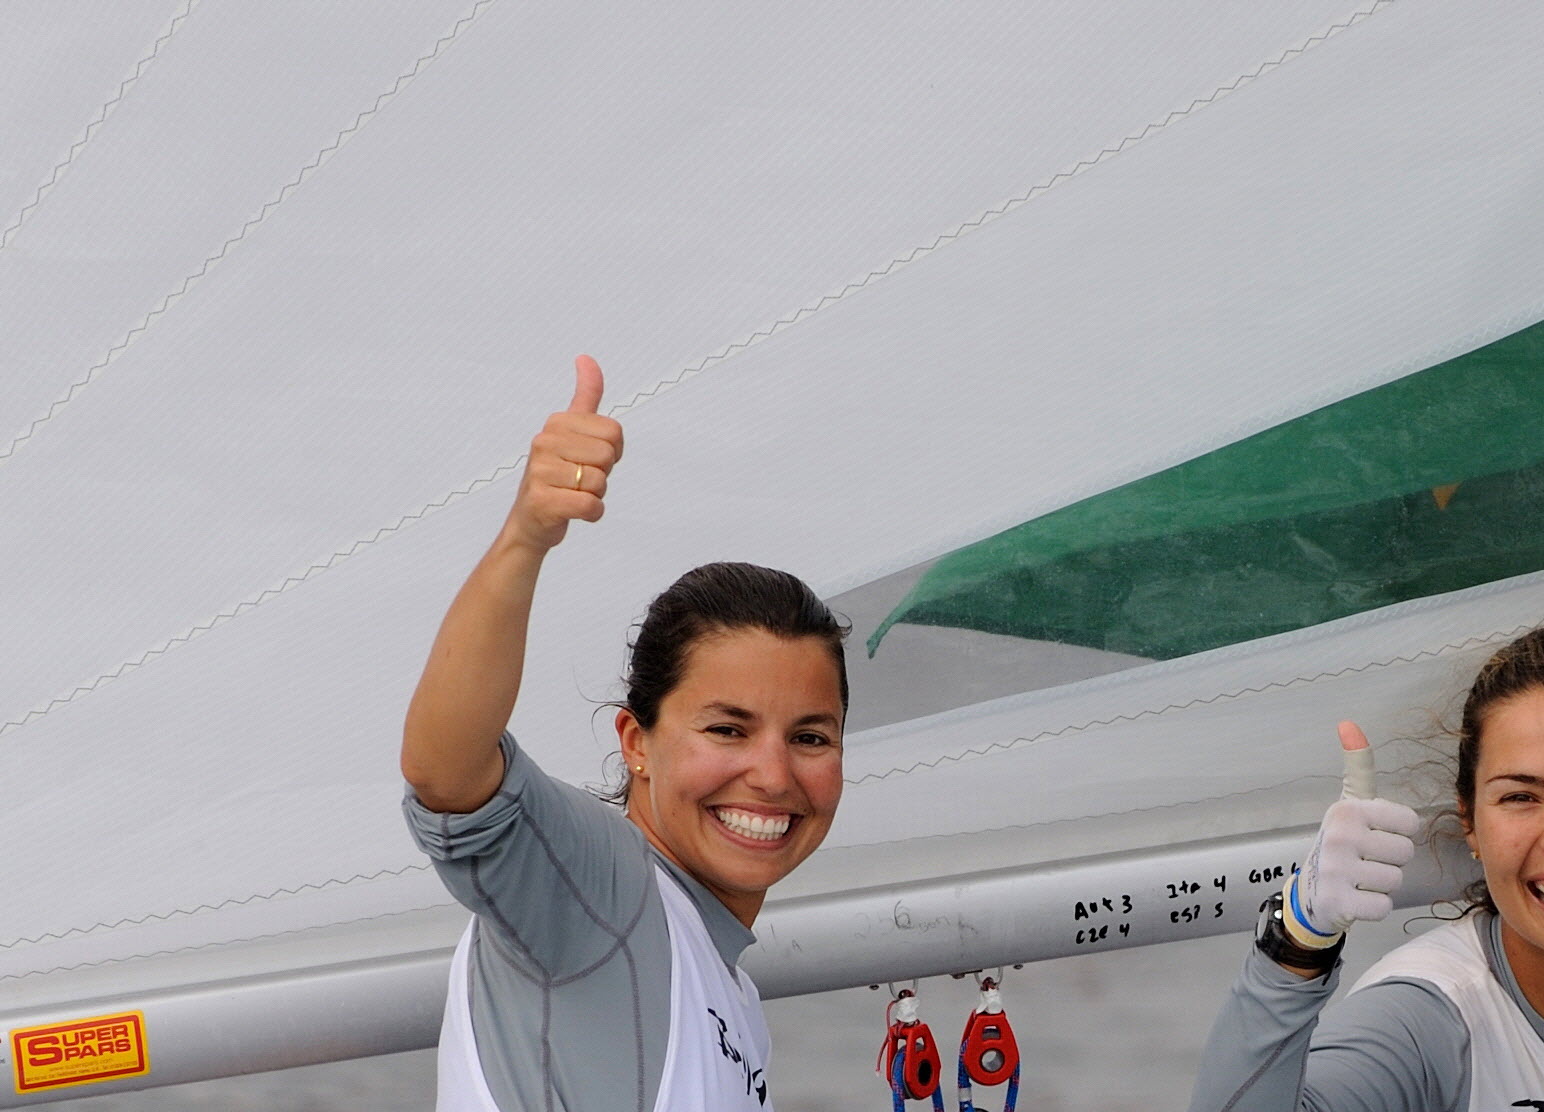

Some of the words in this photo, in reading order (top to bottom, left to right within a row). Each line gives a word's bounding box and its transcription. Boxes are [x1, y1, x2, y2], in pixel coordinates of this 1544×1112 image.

[1249, 866, 1284, 883] GBR
[1213, 875, 1226, 892] 4
[1121, 894, 1133, 914] 3
[1119, 923, 1130, 937] 4
[27, 1024, 129, 1066] SUPER
